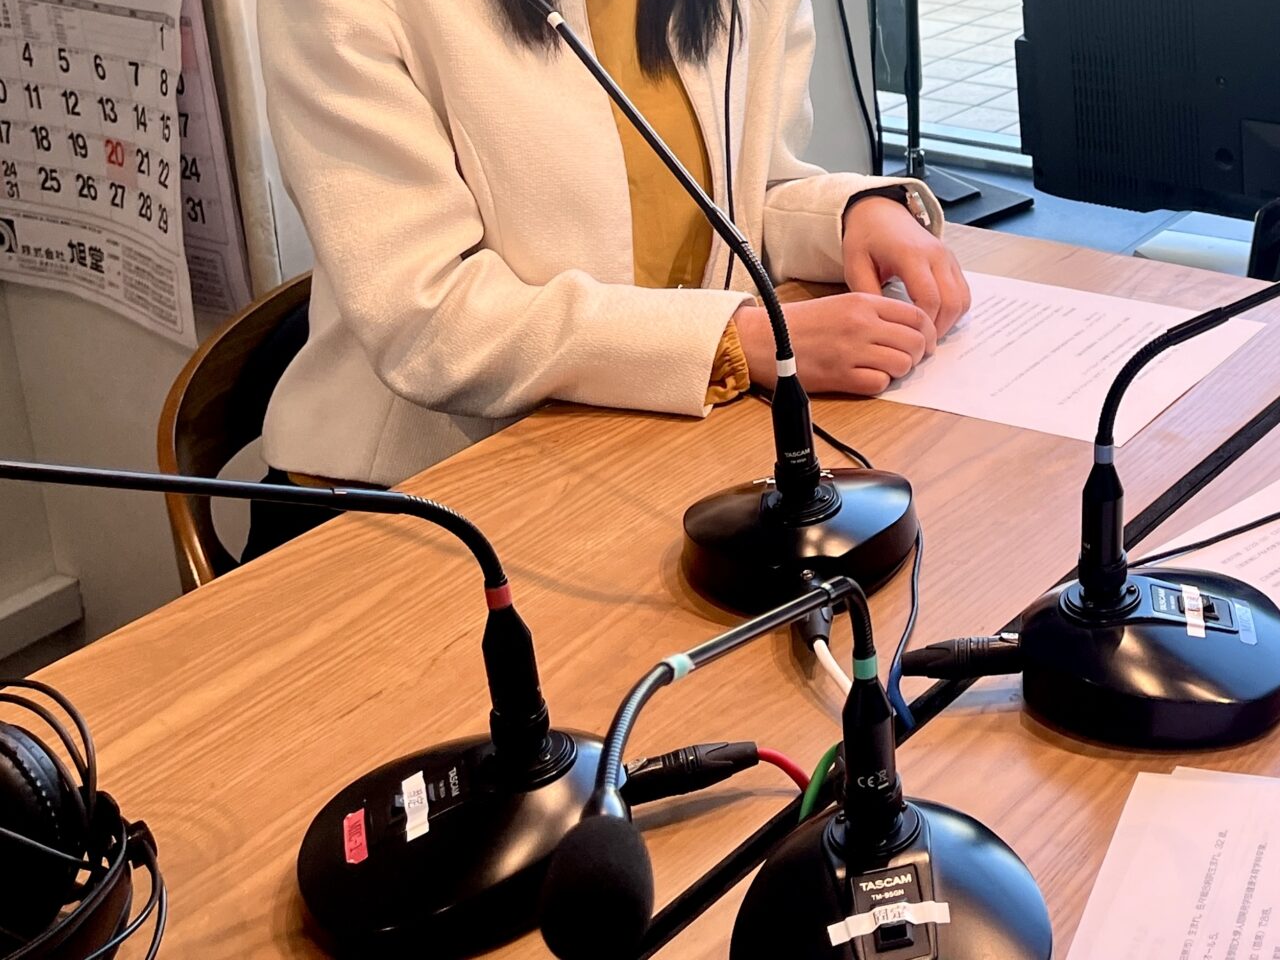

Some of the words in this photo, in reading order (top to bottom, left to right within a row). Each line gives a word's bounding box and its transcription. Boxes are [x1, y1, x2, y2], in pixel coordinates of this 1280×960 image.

[159, 23, 165, 52] 1
[22, 42, 33, 68] 4
[58, 48, 70, 74] 5
[94, 54, 106, 81] 6
[128, 61, 140, 87] 7
[160, 68, 168, 97] 8
[25, 83, 42, 110] 11
[61, 90, 81, 117] 12
[97, 96, 118, 124] 13
[133, 103, 147, 133] 14
[160, 113, 171, 143] 15
[31, 125, 52, 152] 18
[68, 132, 88, 159] 19
[104, 138, 125, 168] 20
[136, 148, 151, 177] 21
[158, 158, 170, 189] 22
[181, 155, 201, 183] 24
[2, 160, 18, 178] 24
[38, 167, 61, 193] 25
[75, 174, 98, 201] 26
[109, 182, 126, 209] 27
[138, 192, 152, 222] 28
[158, 204, 168, 234] 29
[6, 181, 21, 199] 31
[186, 197, 206, 225] 31
[785, 448, 811, 458] TASCAM
[859, 874, 912, 891] TASCAM
